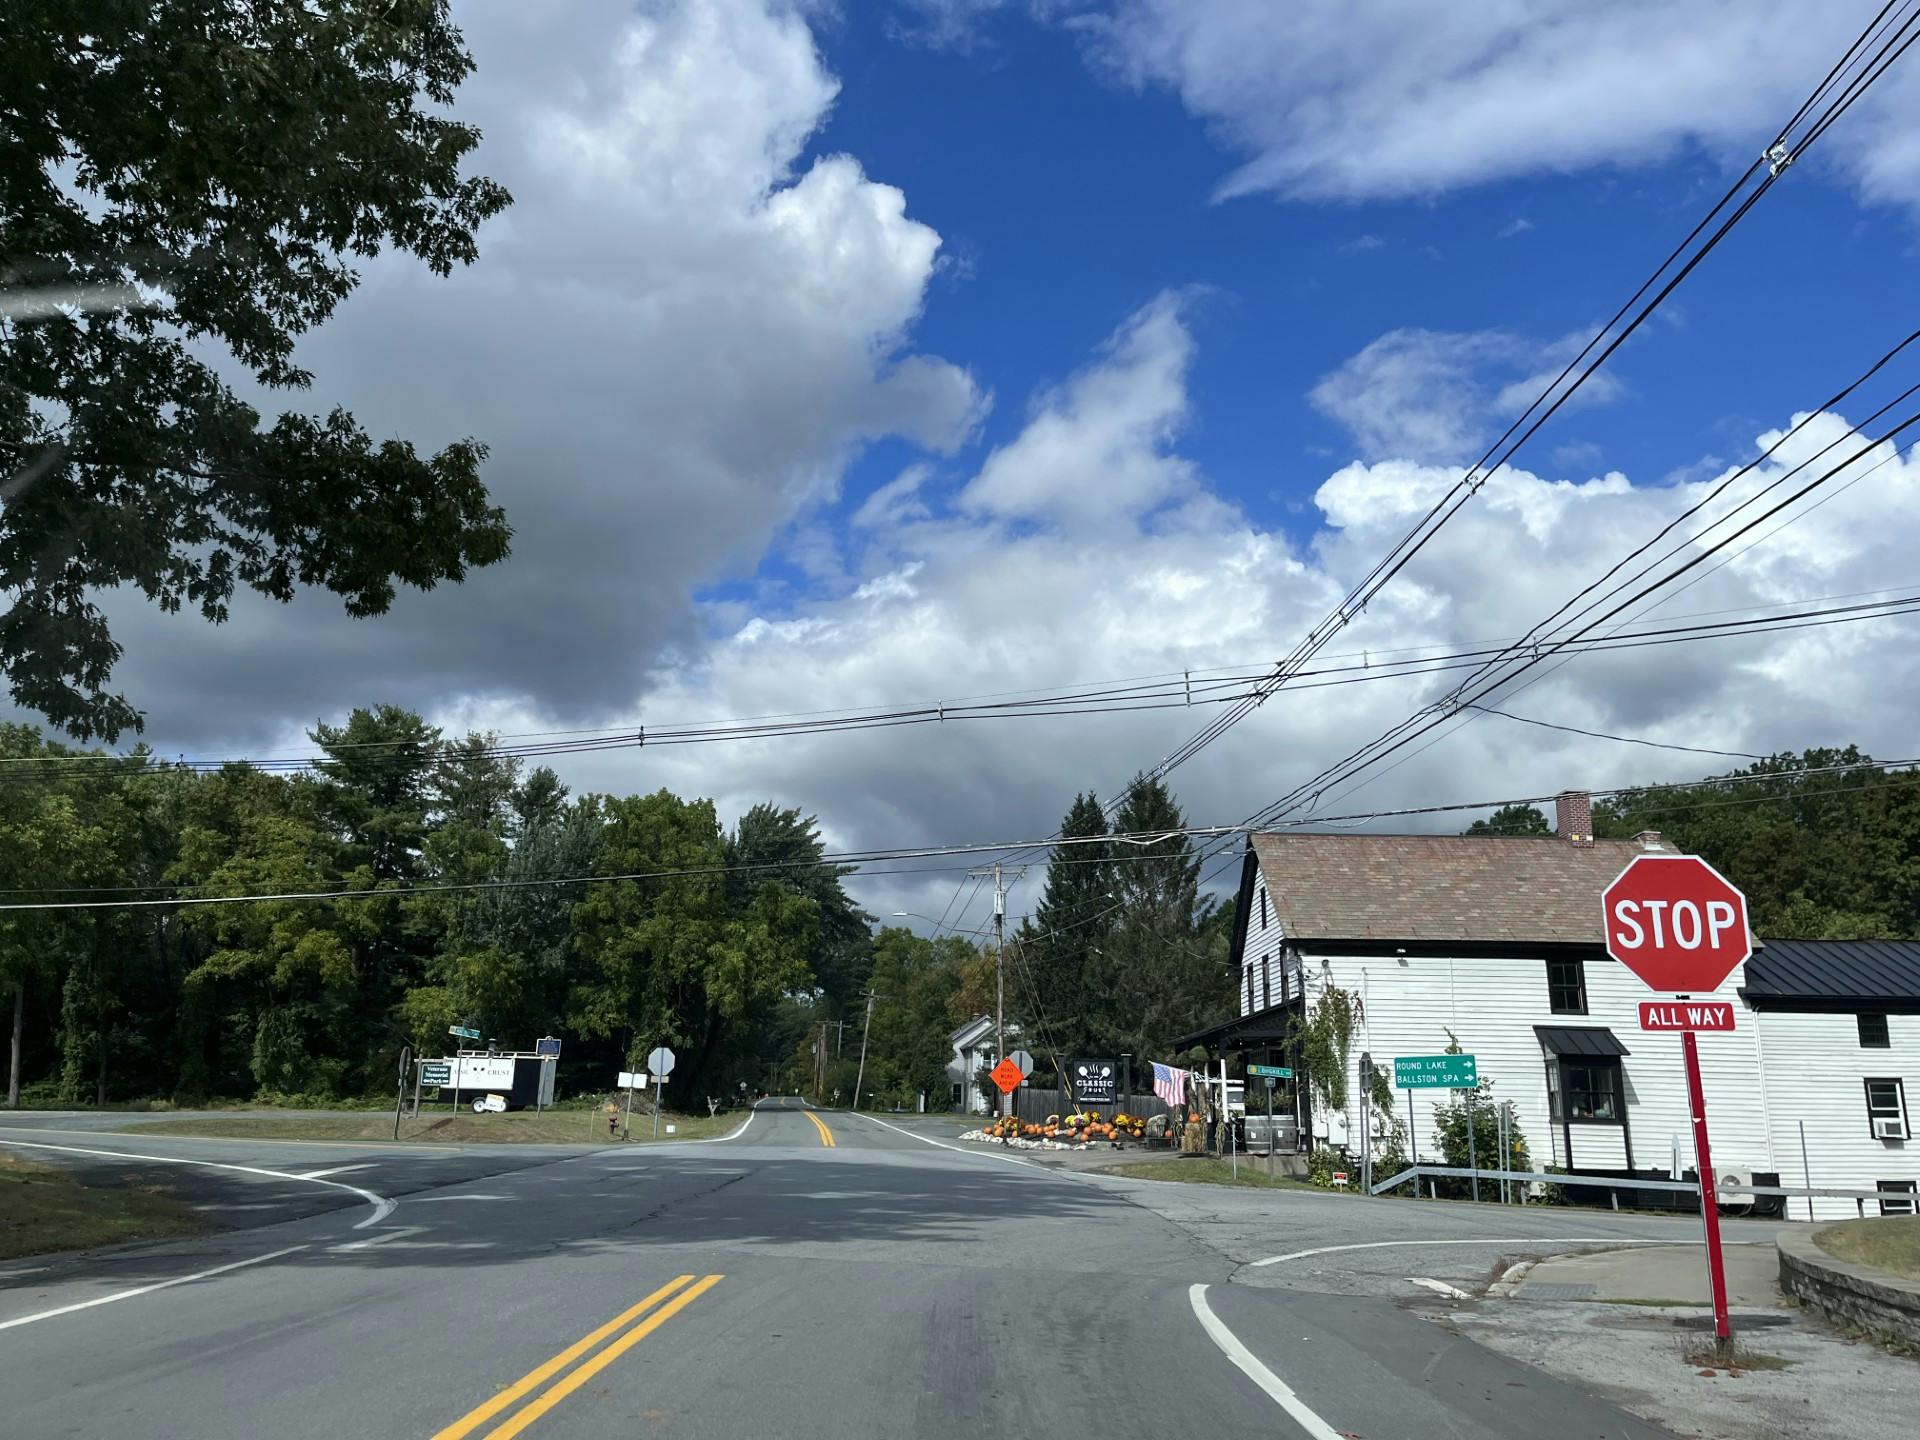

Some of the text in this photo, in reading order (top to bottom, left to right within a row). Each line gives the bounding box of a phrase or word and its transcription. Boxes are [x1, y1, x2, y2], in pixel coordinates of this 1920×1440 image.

[1614, 899, 1736, 950] STOP
[1648, 1007, 1726, 1026] ALL WAY
[1396, 1061, 1448, 1071] ROUND LAKE
[1076, 1079, 1114, 1088] CLASSIC
[1397, 1074, 1460, 1084] BALLSTON SPA
